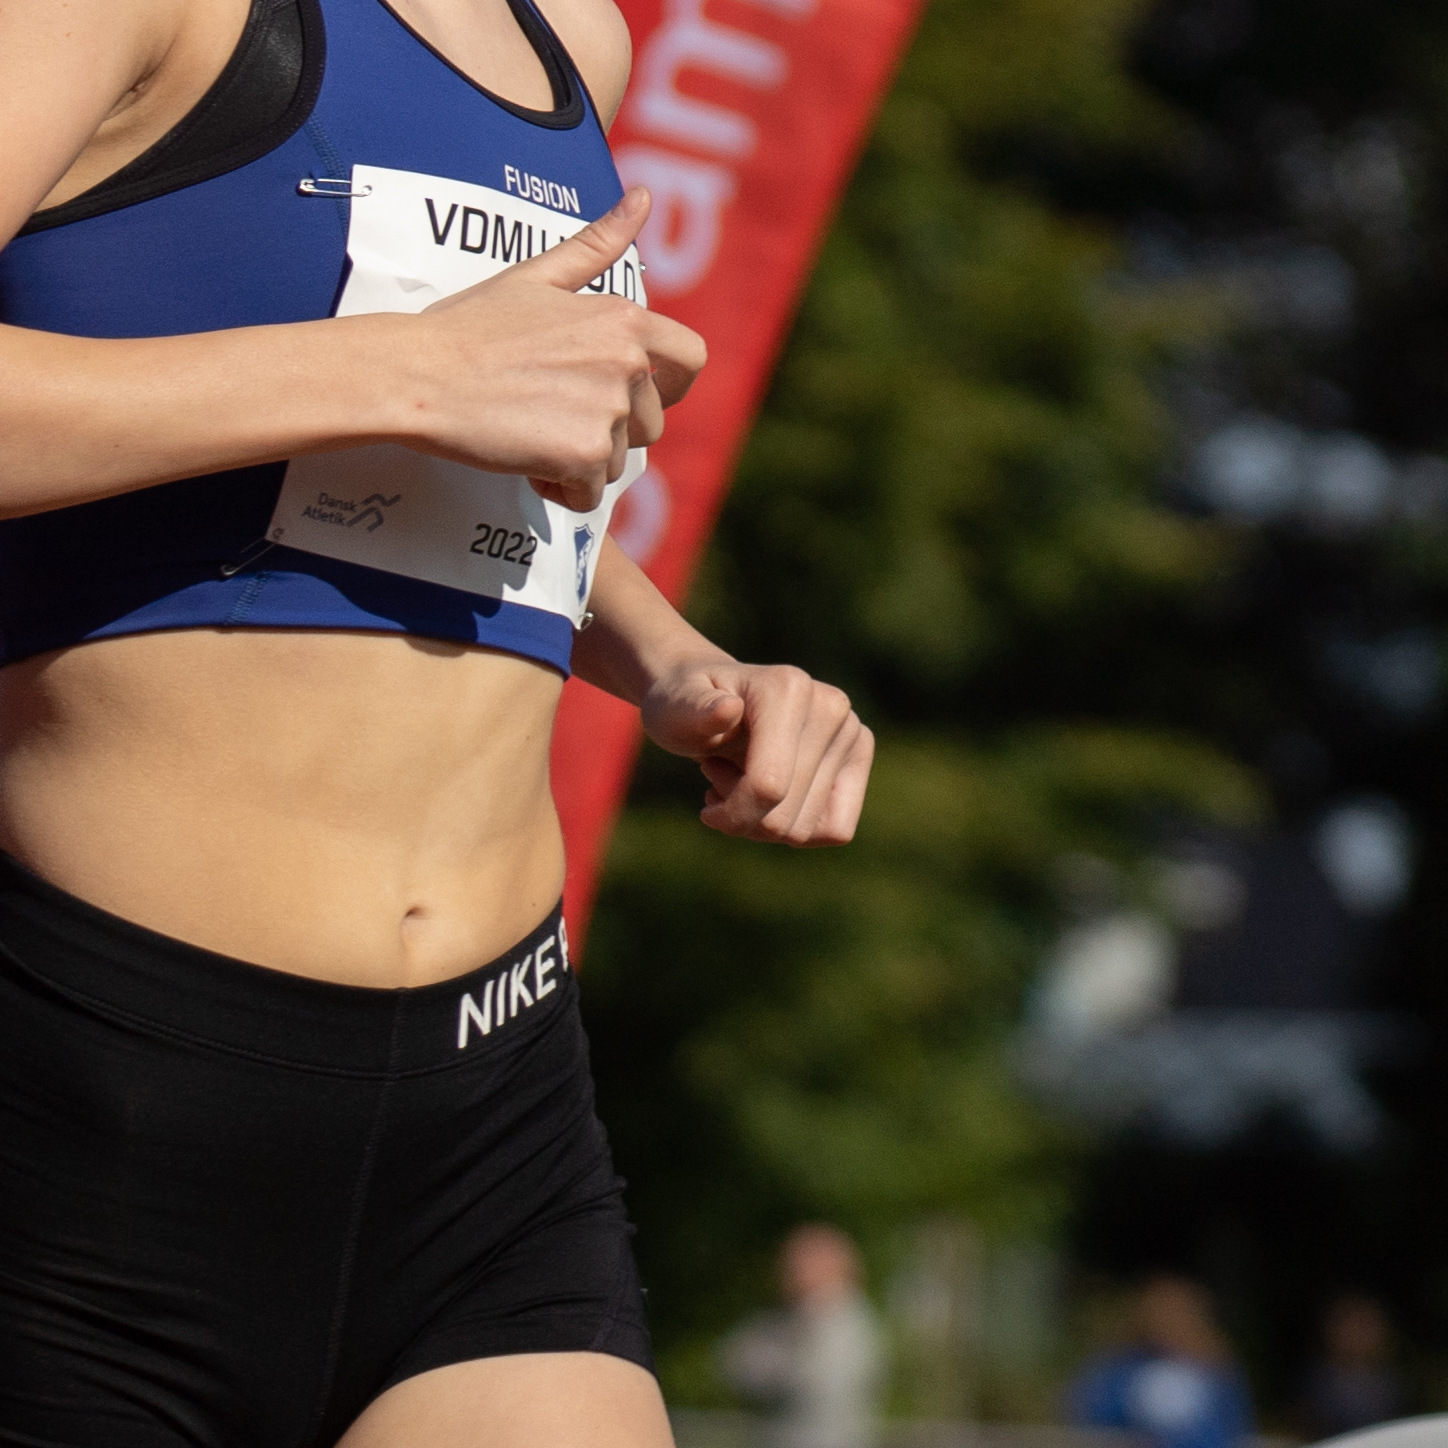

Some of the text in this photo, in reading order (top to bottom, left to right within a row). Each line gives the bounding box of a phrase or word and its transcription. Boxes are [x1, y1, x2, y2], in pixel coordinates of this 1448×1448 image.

[504, 164, 581, 214] FUSION
[470, 523, 538, 567] 2022
[458, 935, 556, 1049] NIKE
